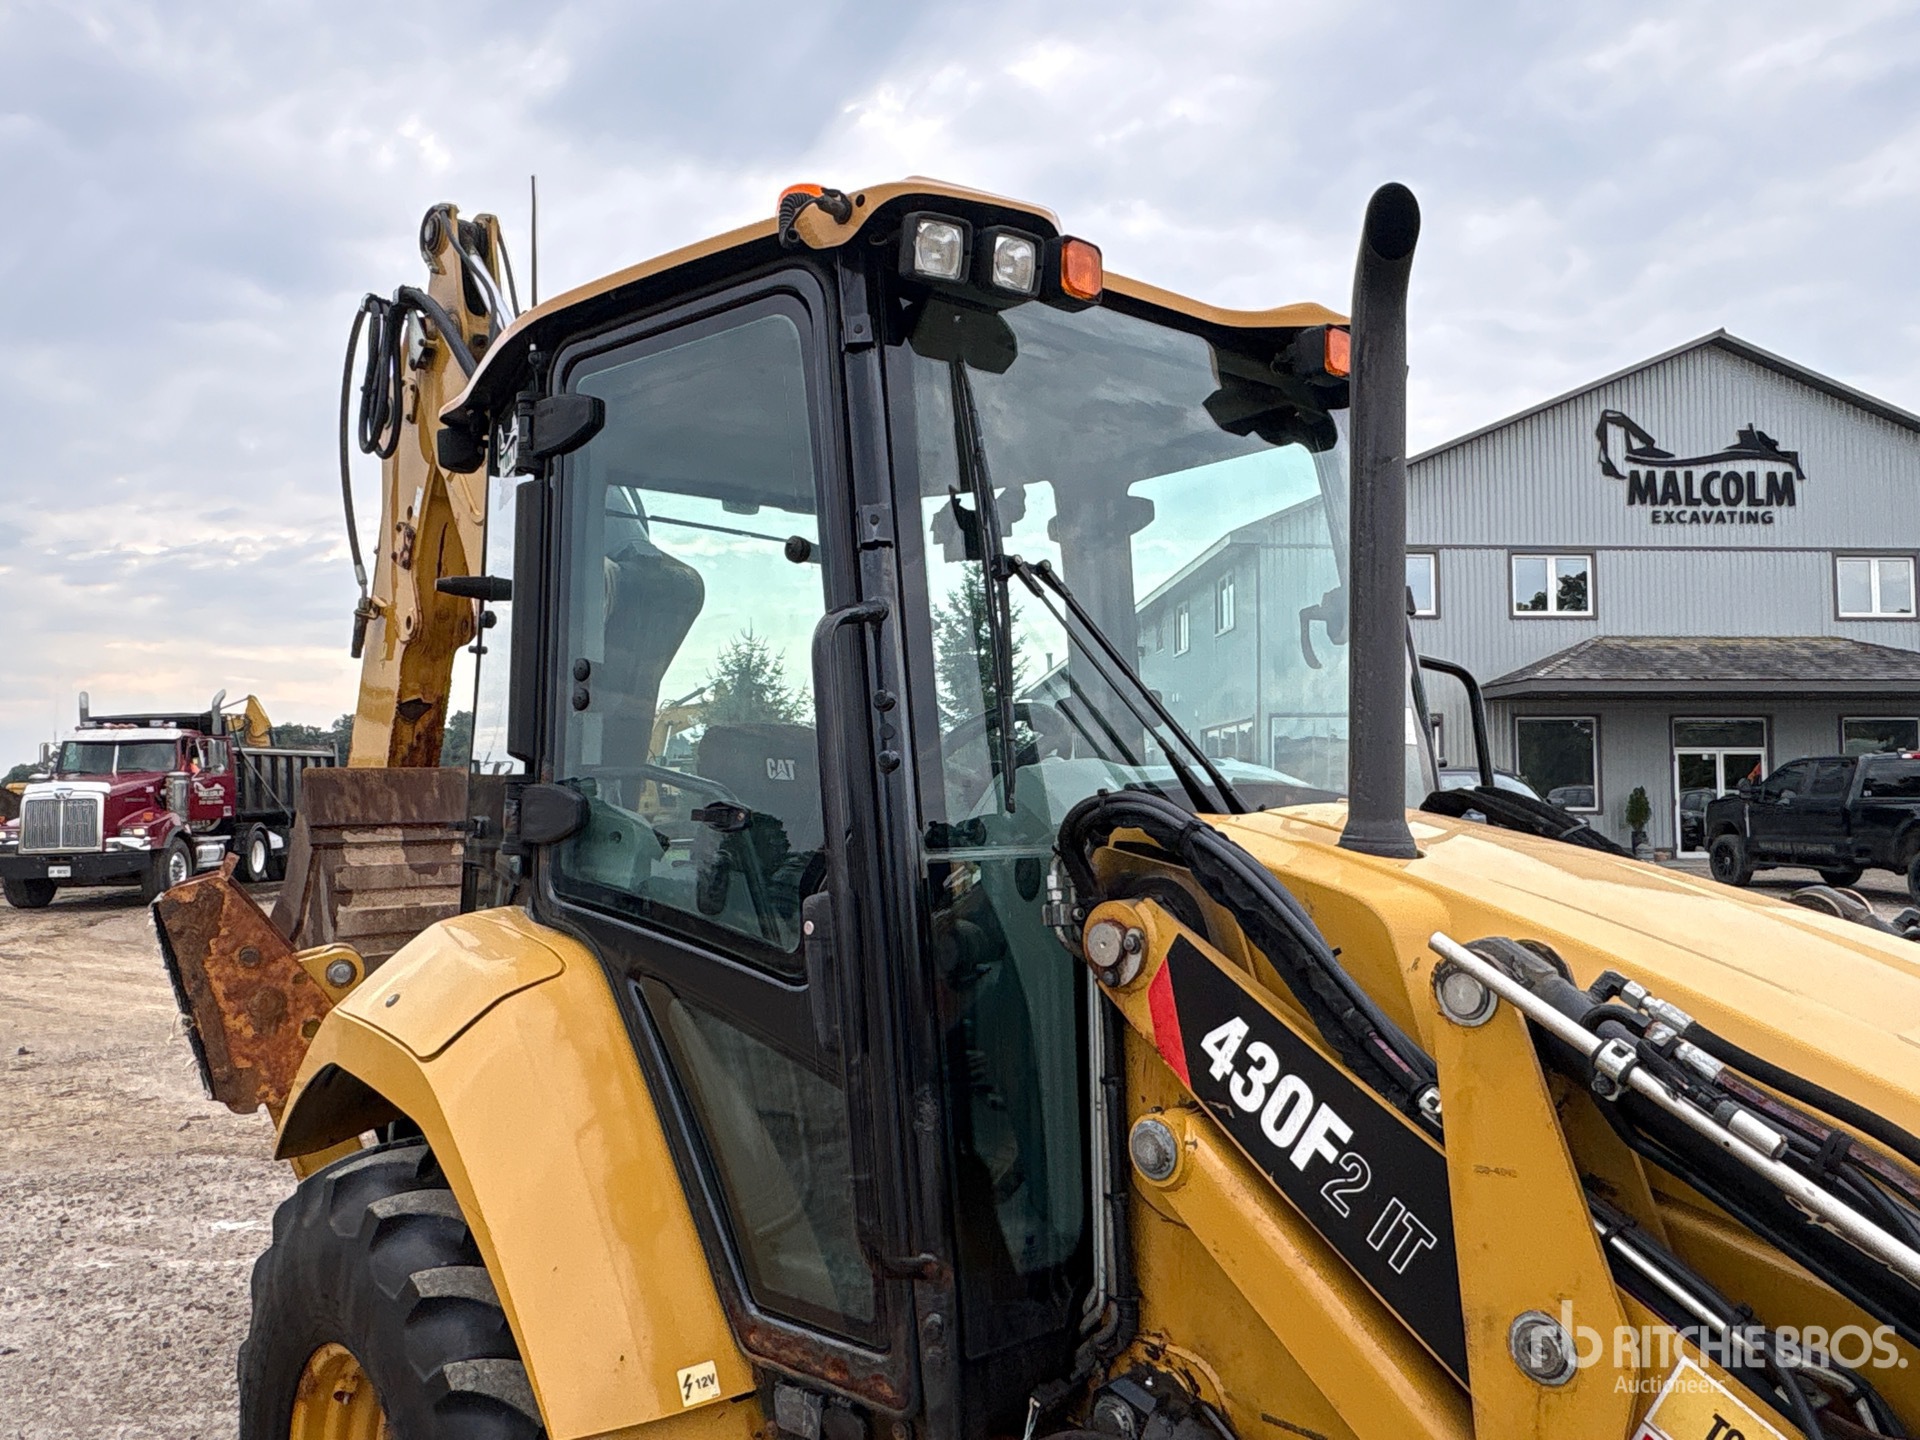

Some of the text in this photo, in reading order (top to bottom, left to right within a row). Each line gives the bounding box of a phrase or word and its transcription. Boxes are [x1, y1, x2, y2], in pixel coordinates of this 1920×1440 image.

[1627, 470, 1796, 506] MALCOLM
[1651, 510, 1774, 525] EXCAVATING
[766, 757, 795, 780] CAT
[1366, 1197, 1437, 1275] IT
[694, 1373, 715, 1389] 12V
